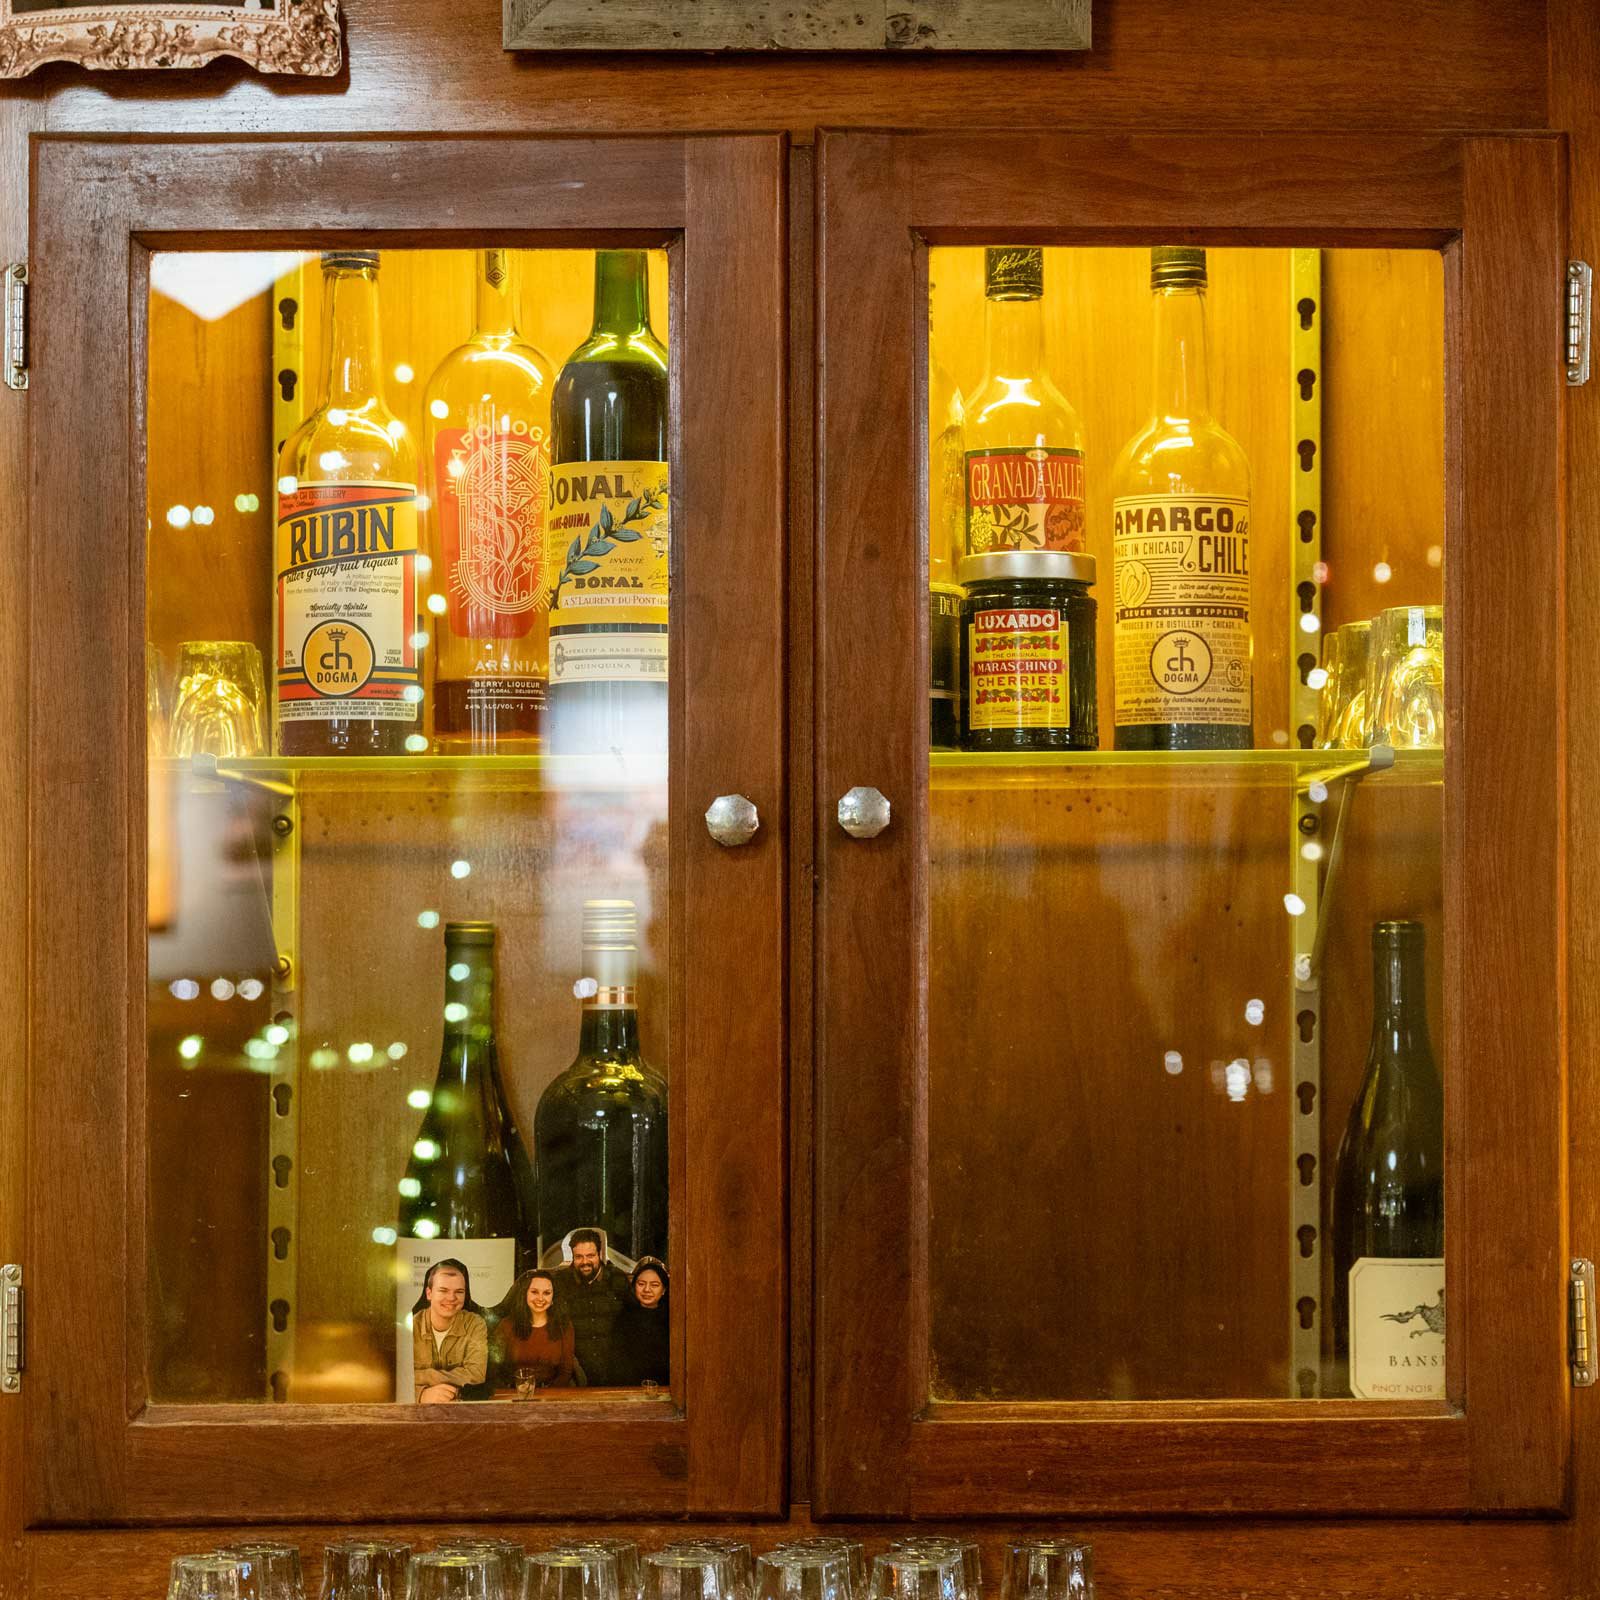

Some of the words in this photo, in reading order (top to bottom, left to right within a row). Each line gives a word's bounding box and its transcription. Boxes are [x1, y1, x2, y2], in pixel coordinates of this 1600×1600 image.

[1115, 506, 1234, 536] AMARGO
[290, 505, 395, 566] RUBIN
[1143, 541, 1184, 555] CHICAGO
[1199, 535, 1248, 575] CHILE
[575, 576, 643, 589] BONAL
[633, 595, 656, 605] PONT
[1125, 608, 1152, 618] SEVEN
[1156, 607, 1191, 616] CHILE
[1196, 607, 1239, 617] PEPPERS
[979, 613, 1055, 630] LUXARDO
[474, 660, 540, 672] ARONIA
[977, 660, 1058, 673] MARASCHINO
[316, 671, 358, 683] DOGMA
[977, 676, 1058, 688] CHERRIES
[1164, 673, 1199, 683] DOGMA
[474, 680, 503, 688] BERRY
[1372, 1384, 1401, 1393] PINOT
[1406, 1384, 1433, 1393] NOIR
